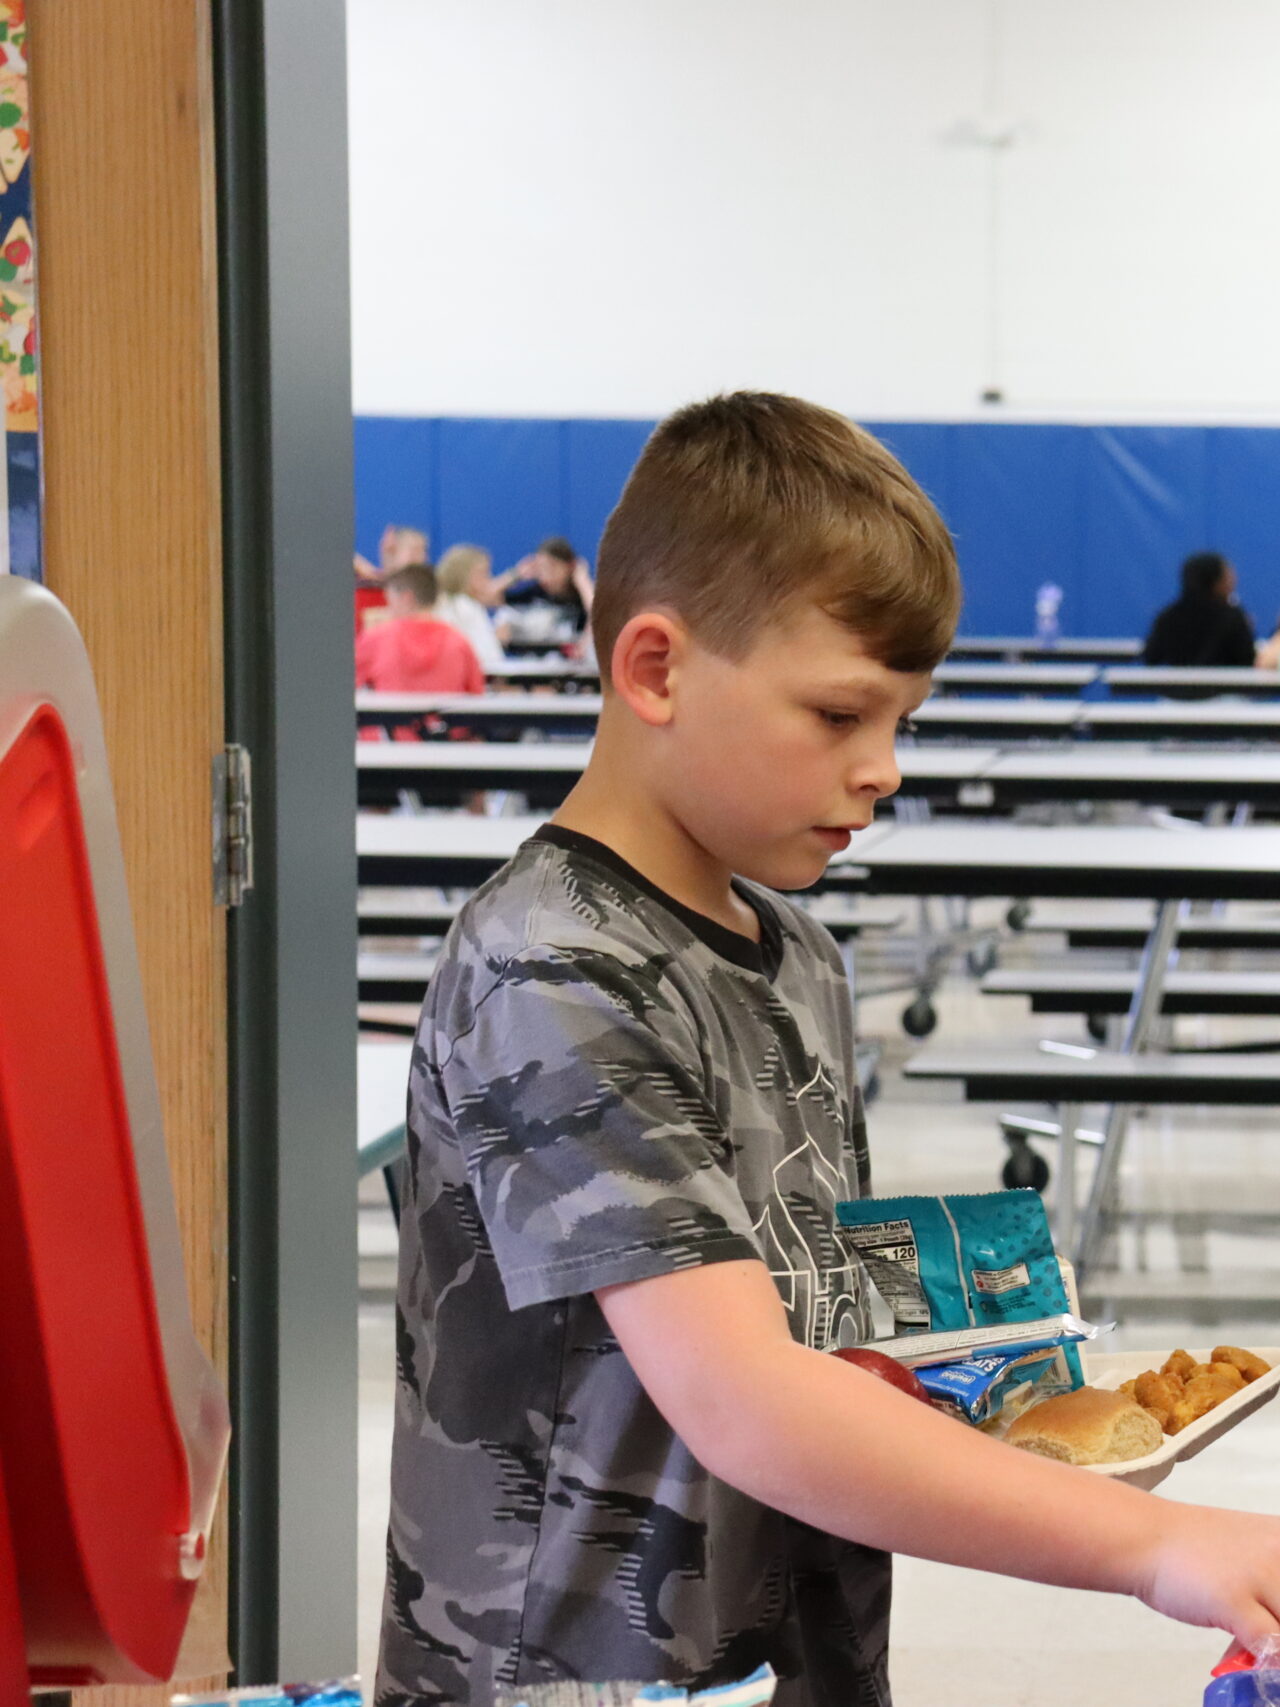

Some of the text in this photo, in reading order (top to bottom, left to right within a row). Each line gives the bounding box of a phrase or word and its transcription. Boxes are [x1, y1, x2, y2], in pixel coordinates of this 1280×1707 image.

[845, 1223, 883, 1235] Nutrition
[884, 1221, 909, 1231] Facts
[892, 1247, 915, 1259] 120
